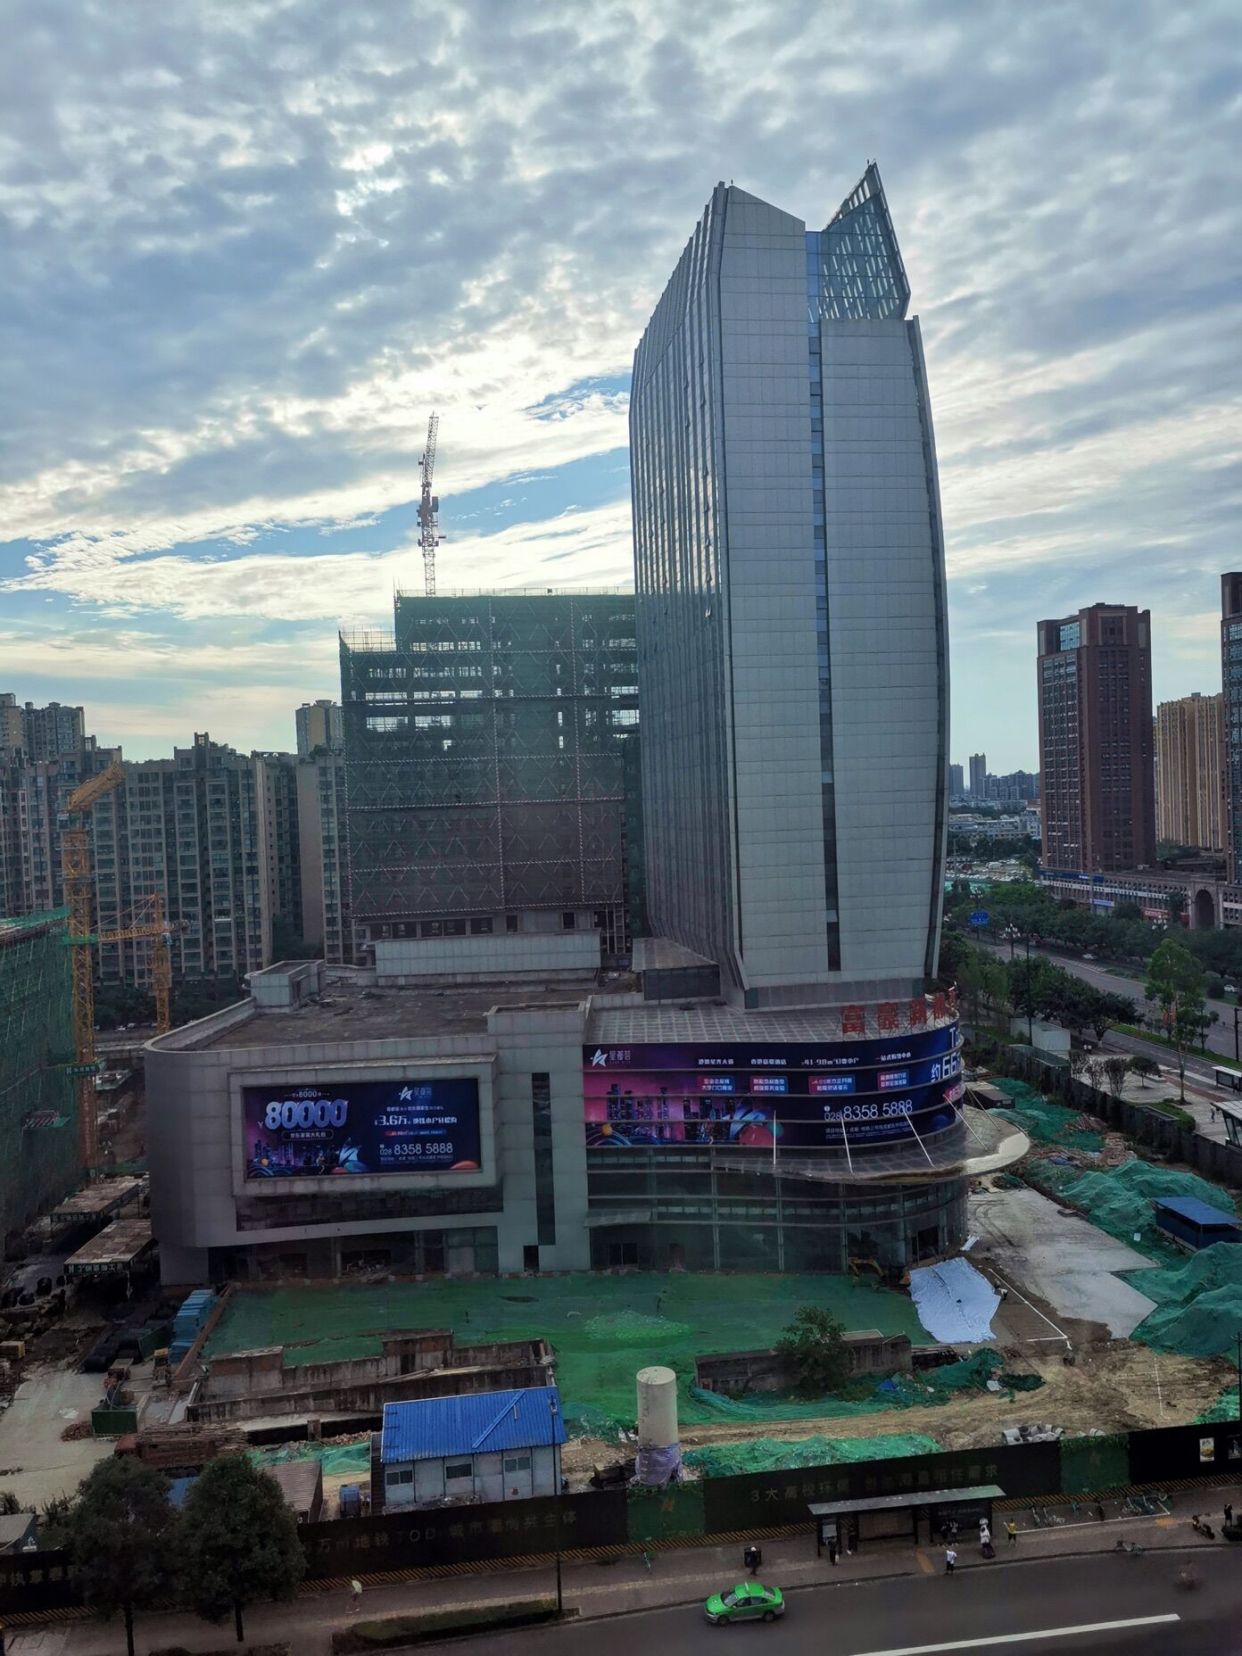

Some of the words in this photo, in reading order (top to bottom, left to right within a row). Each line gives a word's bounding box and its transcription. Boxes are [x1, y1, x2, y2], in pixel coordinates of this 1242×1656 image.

[843, 1104, 878, 1120] 8358
[883, 1099, 913, 1116] 5888
[394, 1144, 422, 1155] 8358
[426, 1142, 454, 1154] 5888
